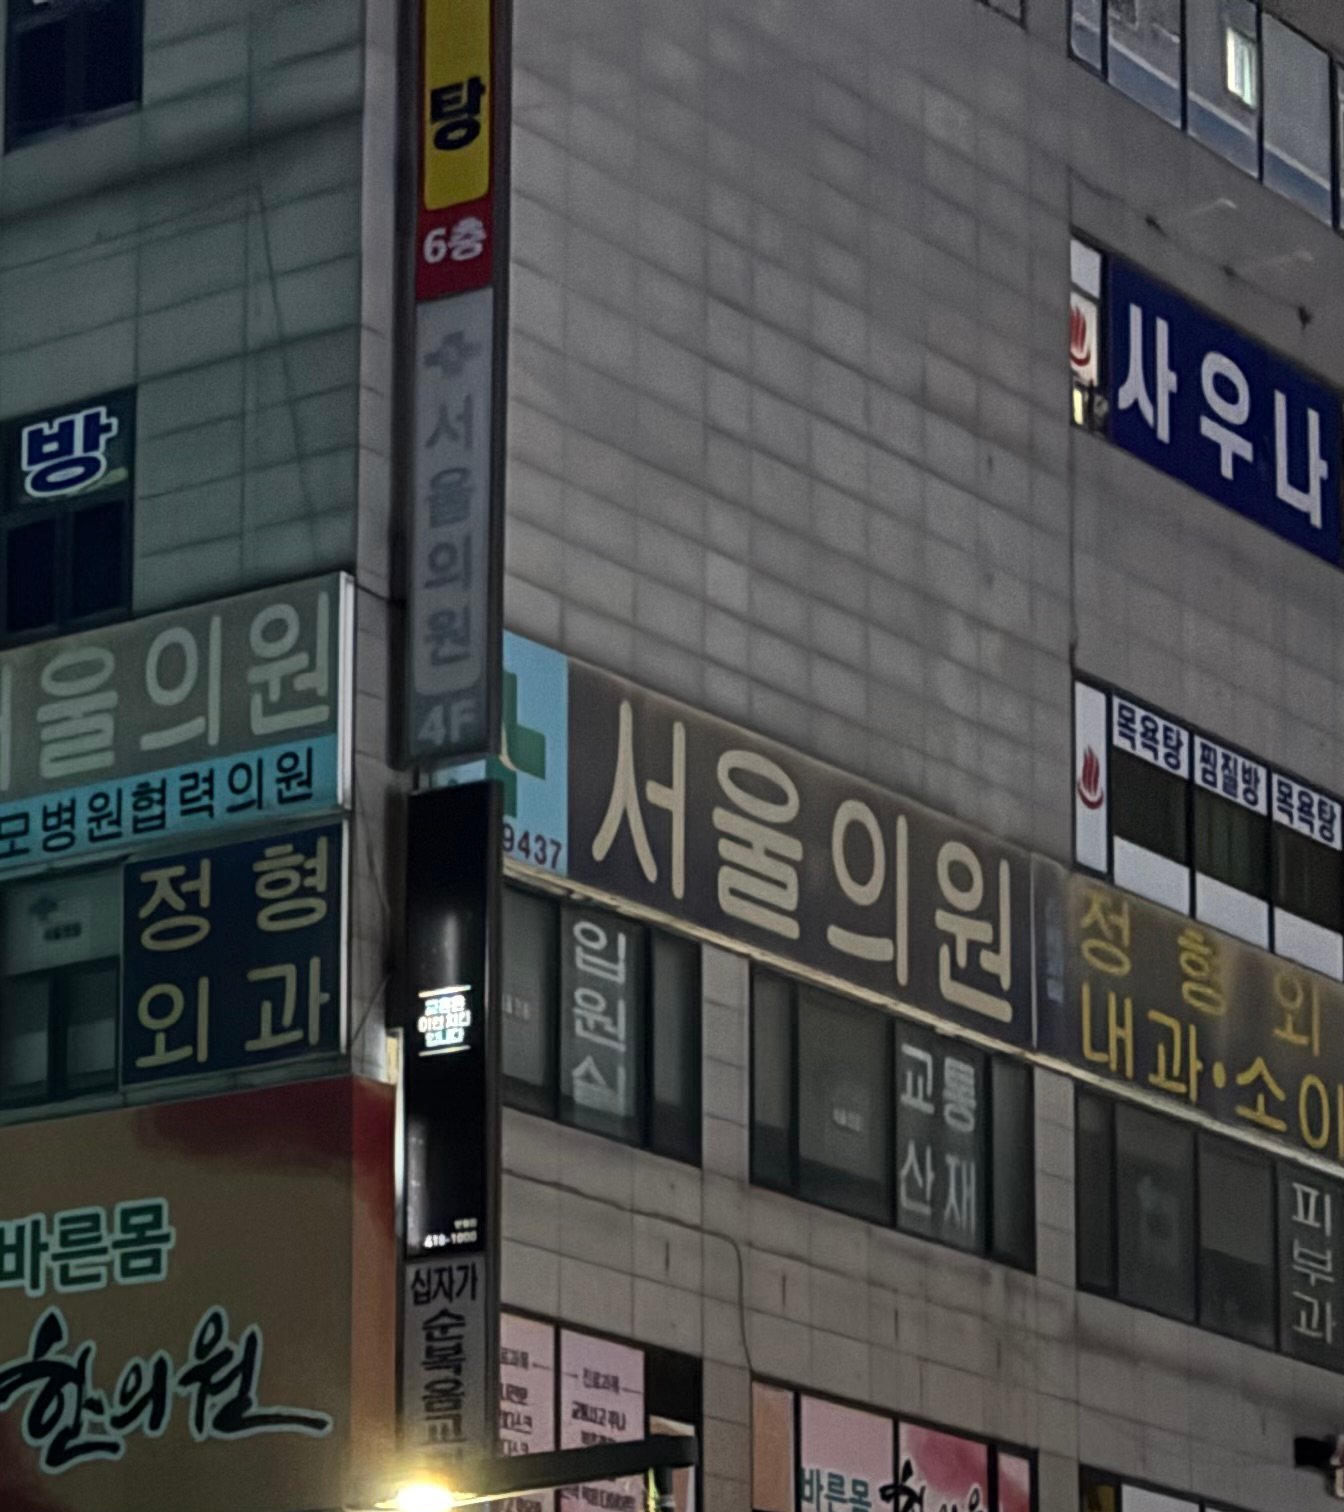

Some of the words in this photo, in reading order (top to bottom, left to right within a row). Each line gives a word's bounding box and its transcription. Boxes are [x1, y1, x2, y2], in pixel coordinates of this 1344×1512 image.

[431, 76, 486, 150] 탕
[423, 217, 486, 263] 6층
[1118, 303, 1328, 528] 사우나
[425, 394, 475, 667] 서울의원
[418, 705, 478, 746] 4F
[138, 836, 327, 952] 정형
[592, 701, 1012, 1023] 서울의원
[135, 956, 330, 1068] 외과
[900, 1043, 975, 1132] 교통
[900, 1140, 976, 1235] 산재
[411, 1262, 478, 1306] 십자가
